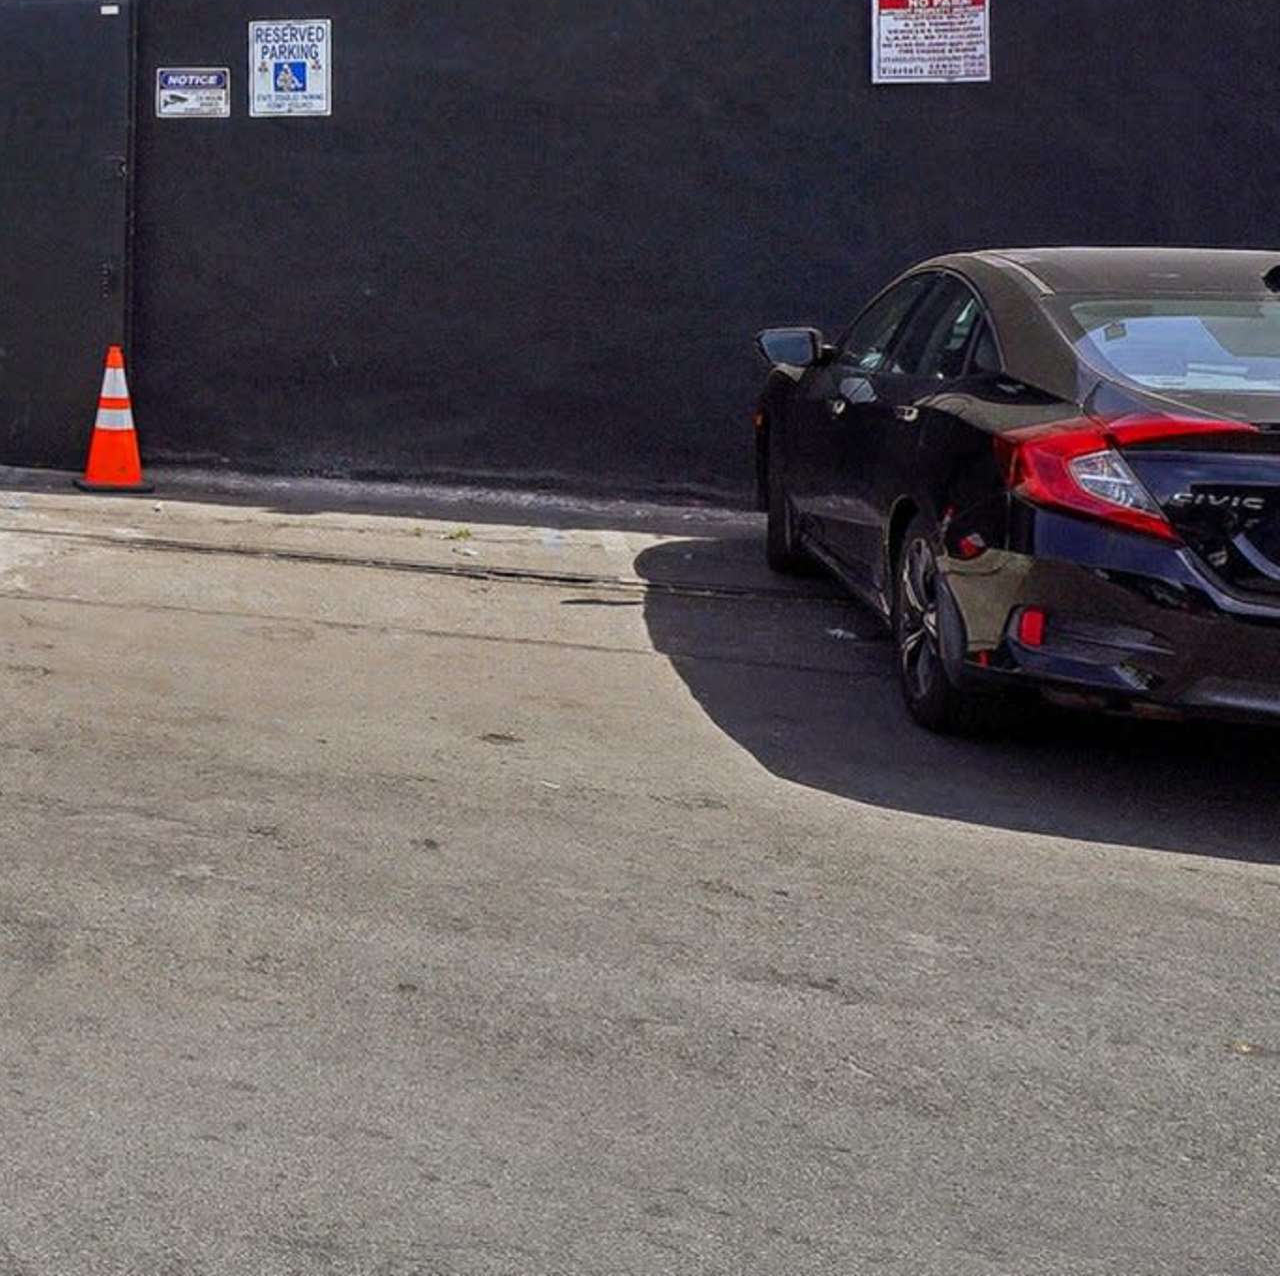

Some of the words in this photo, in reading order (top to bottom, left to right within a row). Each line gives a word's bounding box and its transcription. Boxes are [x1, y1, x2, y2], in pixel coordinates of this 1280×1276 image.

[256, 26, 325, 44] RESERVED
[261, 43, 319, 60] PARKING
[167, 74, 218, 85] NOTICE
[1173, 492, 1265, 510] CIVIC
